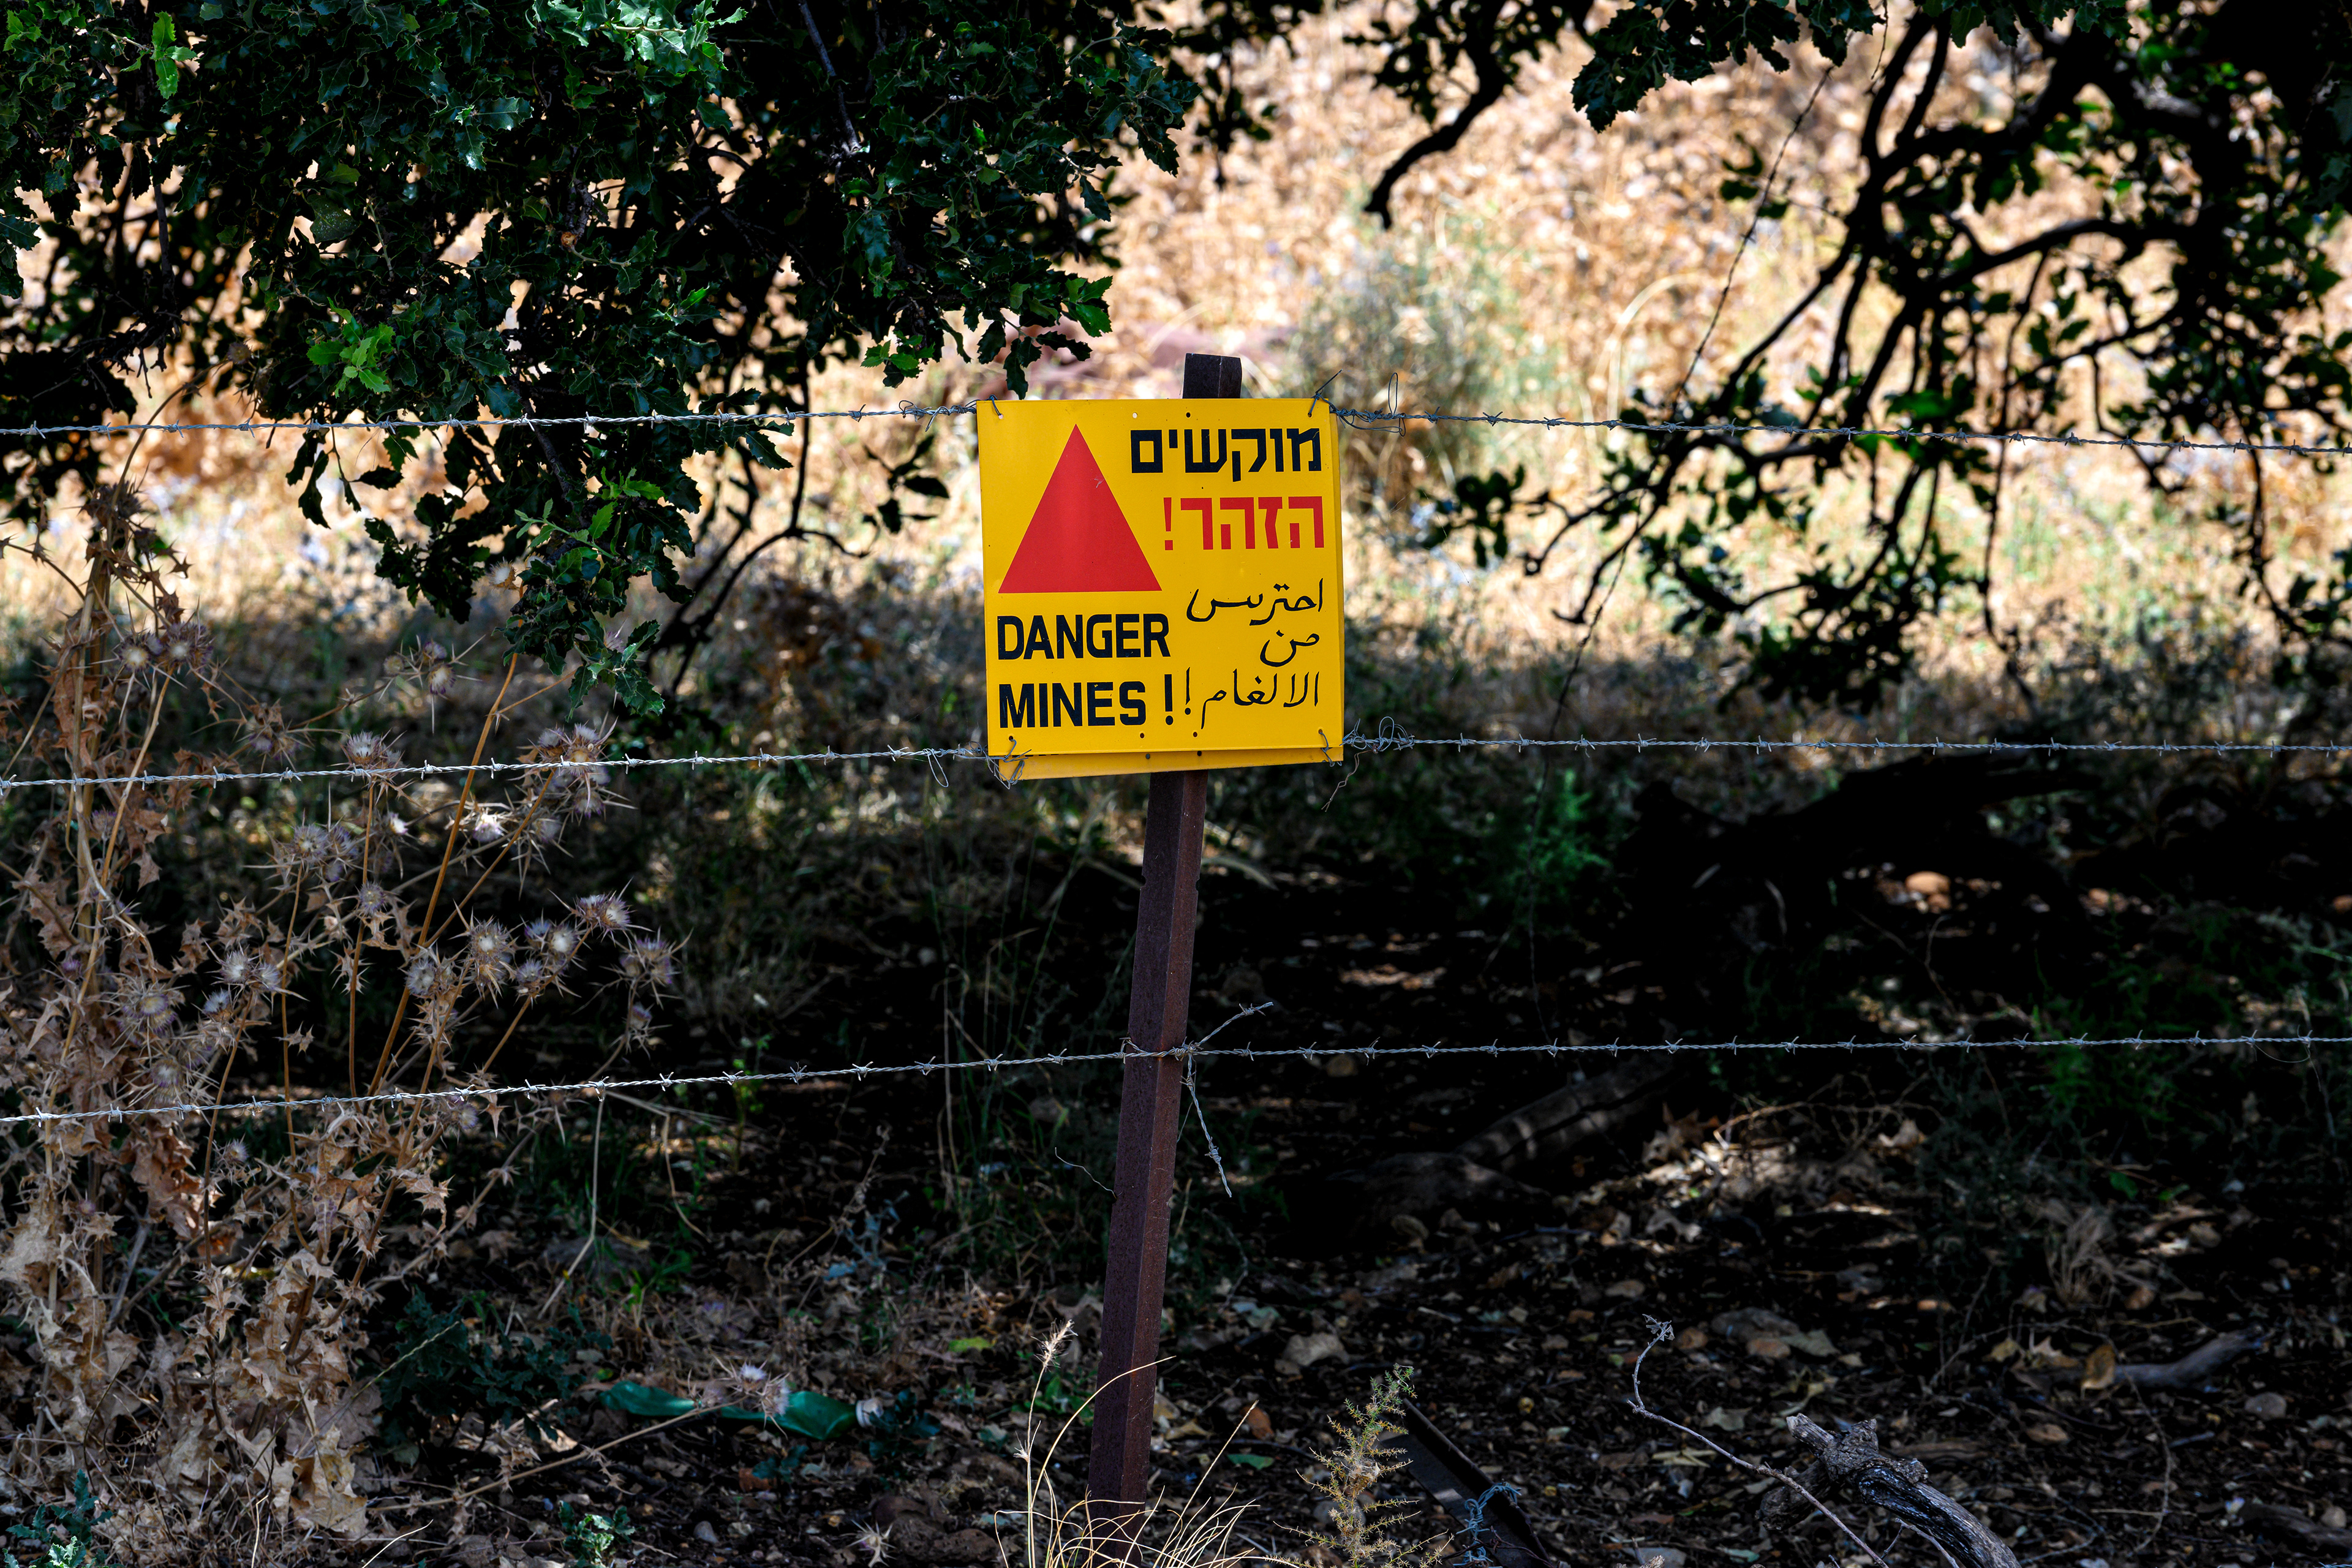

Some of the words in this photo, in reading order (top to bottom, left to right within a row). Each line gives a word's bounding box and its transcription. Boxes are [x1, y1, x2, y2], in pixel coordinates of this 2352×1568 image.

[1130, 428, 1322, 483] מוקשים
[1163, 496, 1325, 551] הזהר!
[1186, 578, 1324, 627] احترس
[997, 613, 1171, 660] DANGER
[1259, 629, 1320, 668] من
